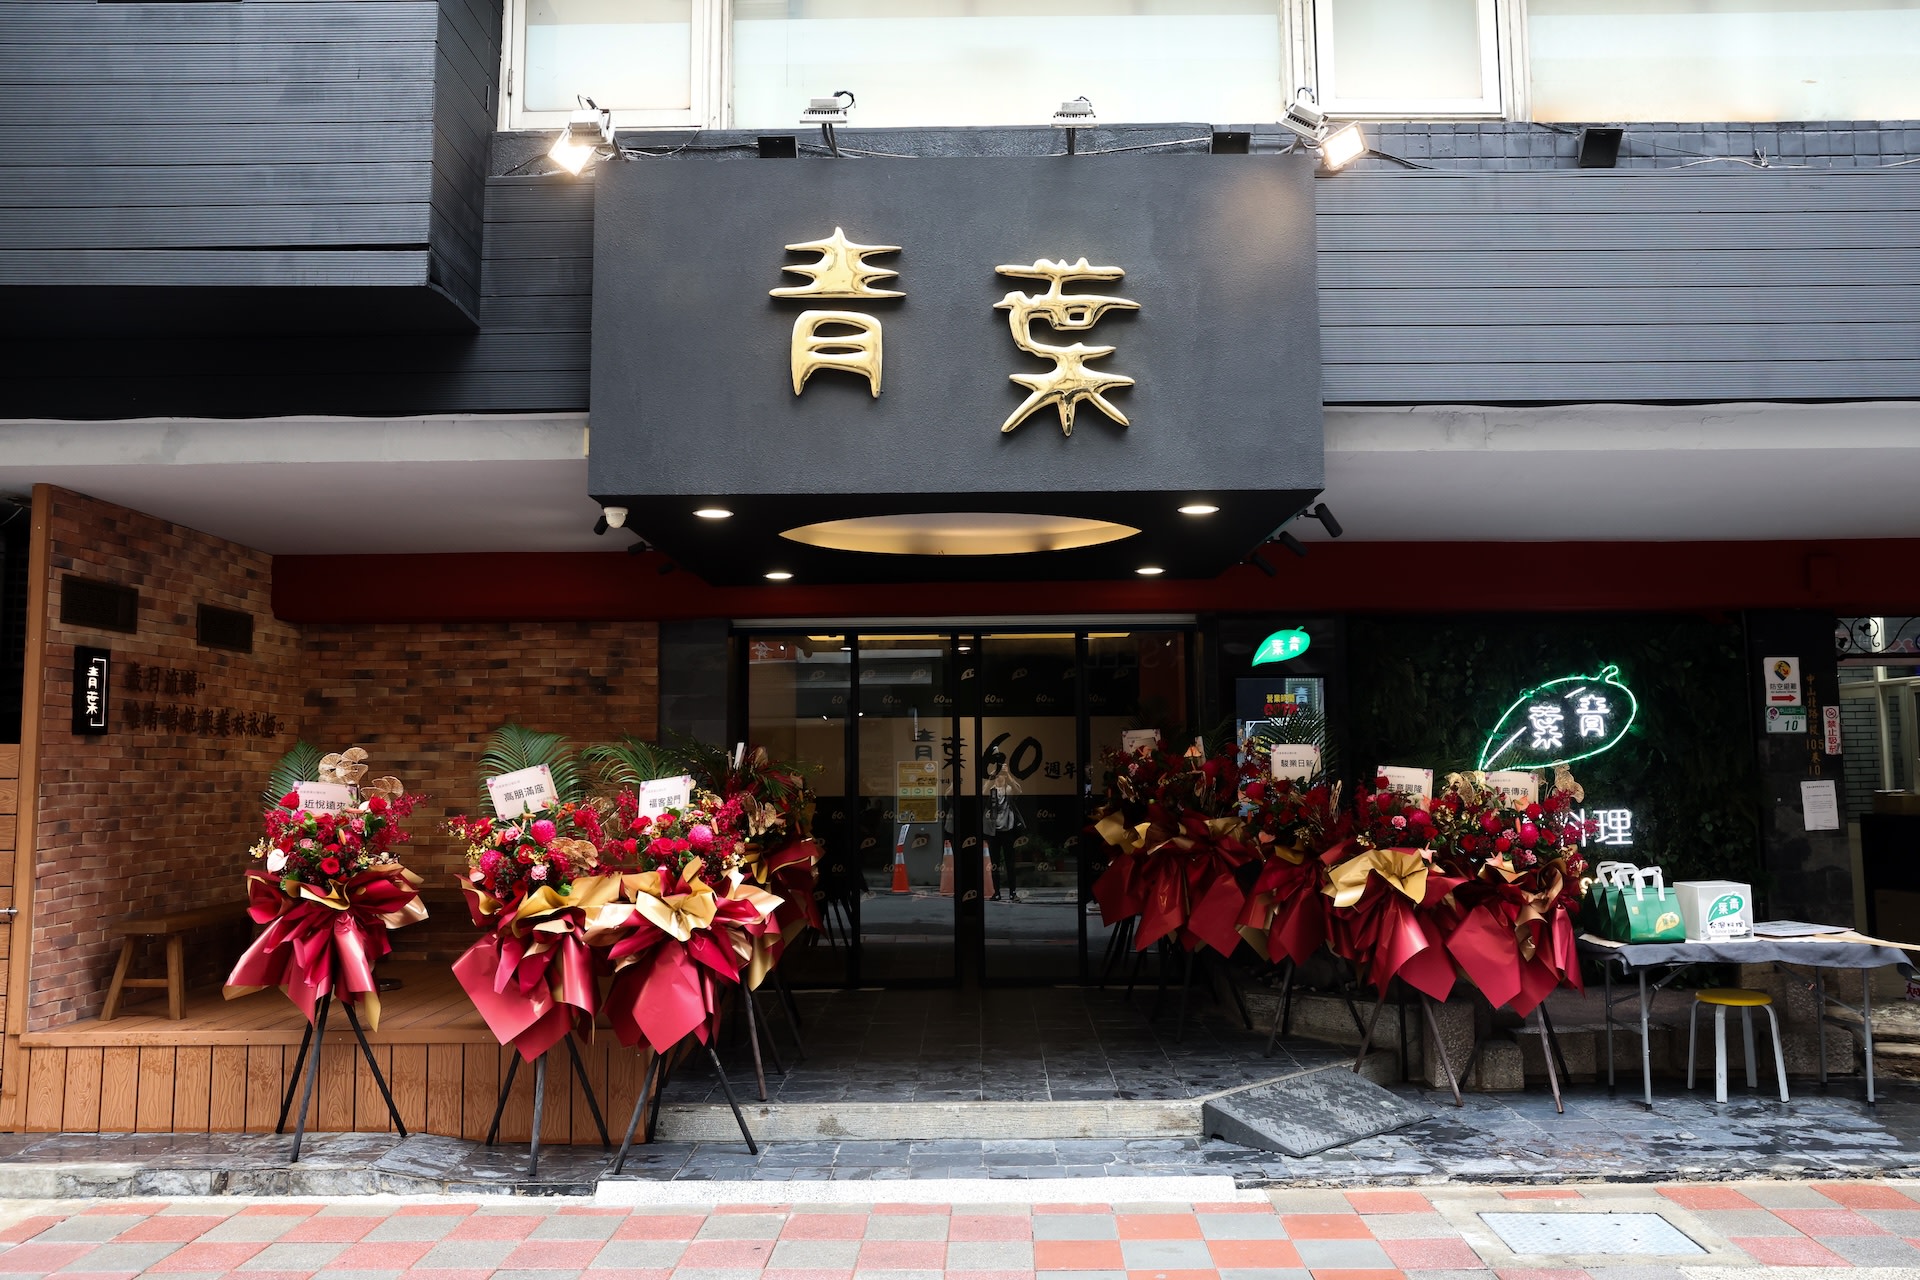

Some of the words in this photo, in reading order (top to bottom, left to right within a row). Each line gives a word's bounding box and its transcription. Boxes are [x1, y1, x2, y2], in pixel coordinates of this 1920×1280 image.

[769, 227, 1140, 437] 青葉
[85, 666, 100, 716] 青葉
[1784, 719, 1799, 731] 10
[503, 783, 545, 802] 高朋滿座
[1502, 787, 1529, 796] 典傳承
[304, 799, 346, 811] 近悅遠來
